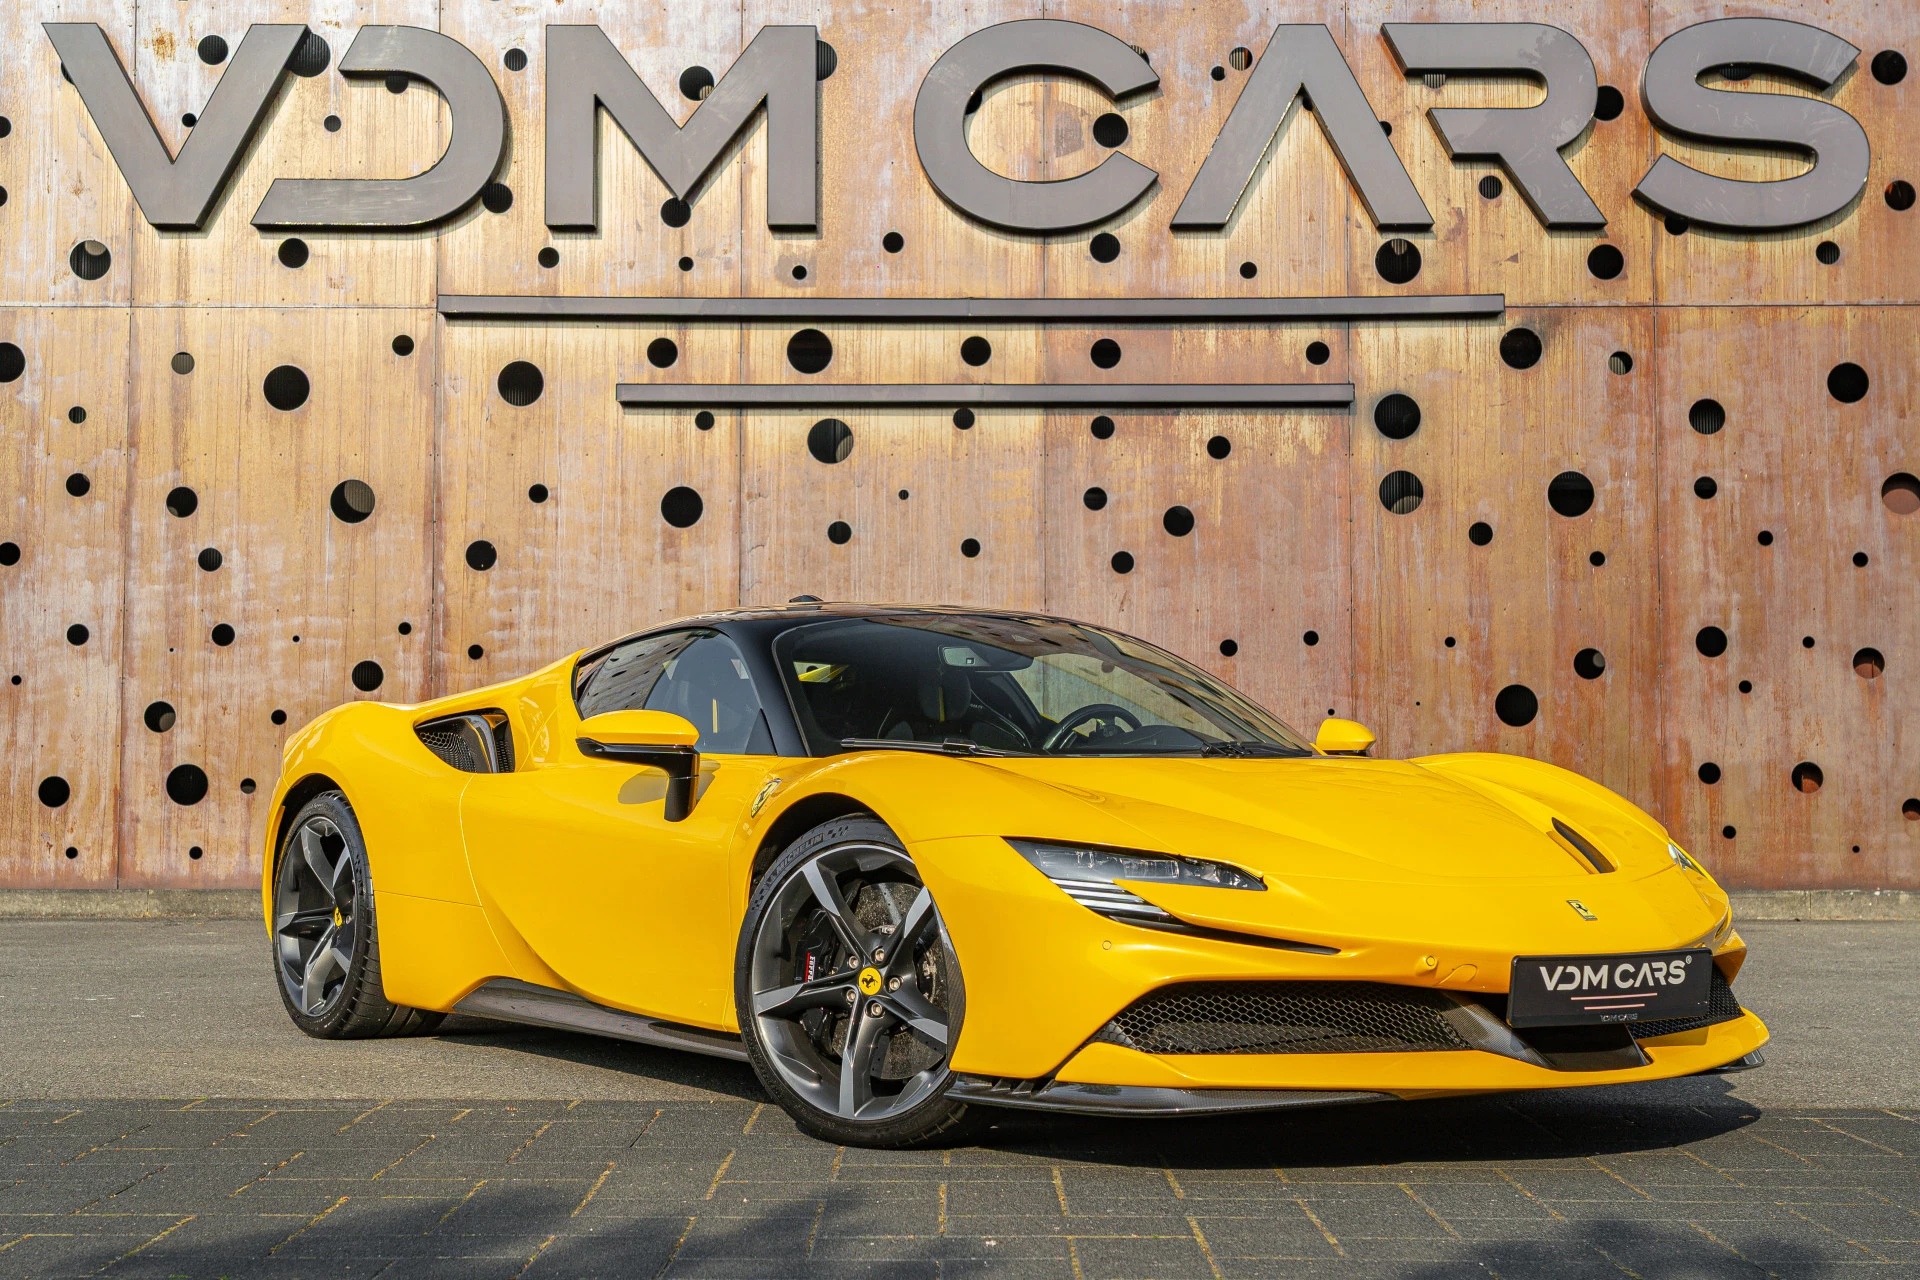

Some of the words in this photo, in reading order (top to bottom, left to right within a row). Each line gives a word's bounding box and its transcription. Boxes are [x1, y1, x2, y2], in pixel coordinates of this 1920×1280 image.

[41, 22, 818, 232] VDM
[912, 17, 1871, 234] CARS
[776, 832, 824, 876] MICHELIN
[807, 955, 816, 982] Ferra
[1539, 964, 1609, 991] VDM
